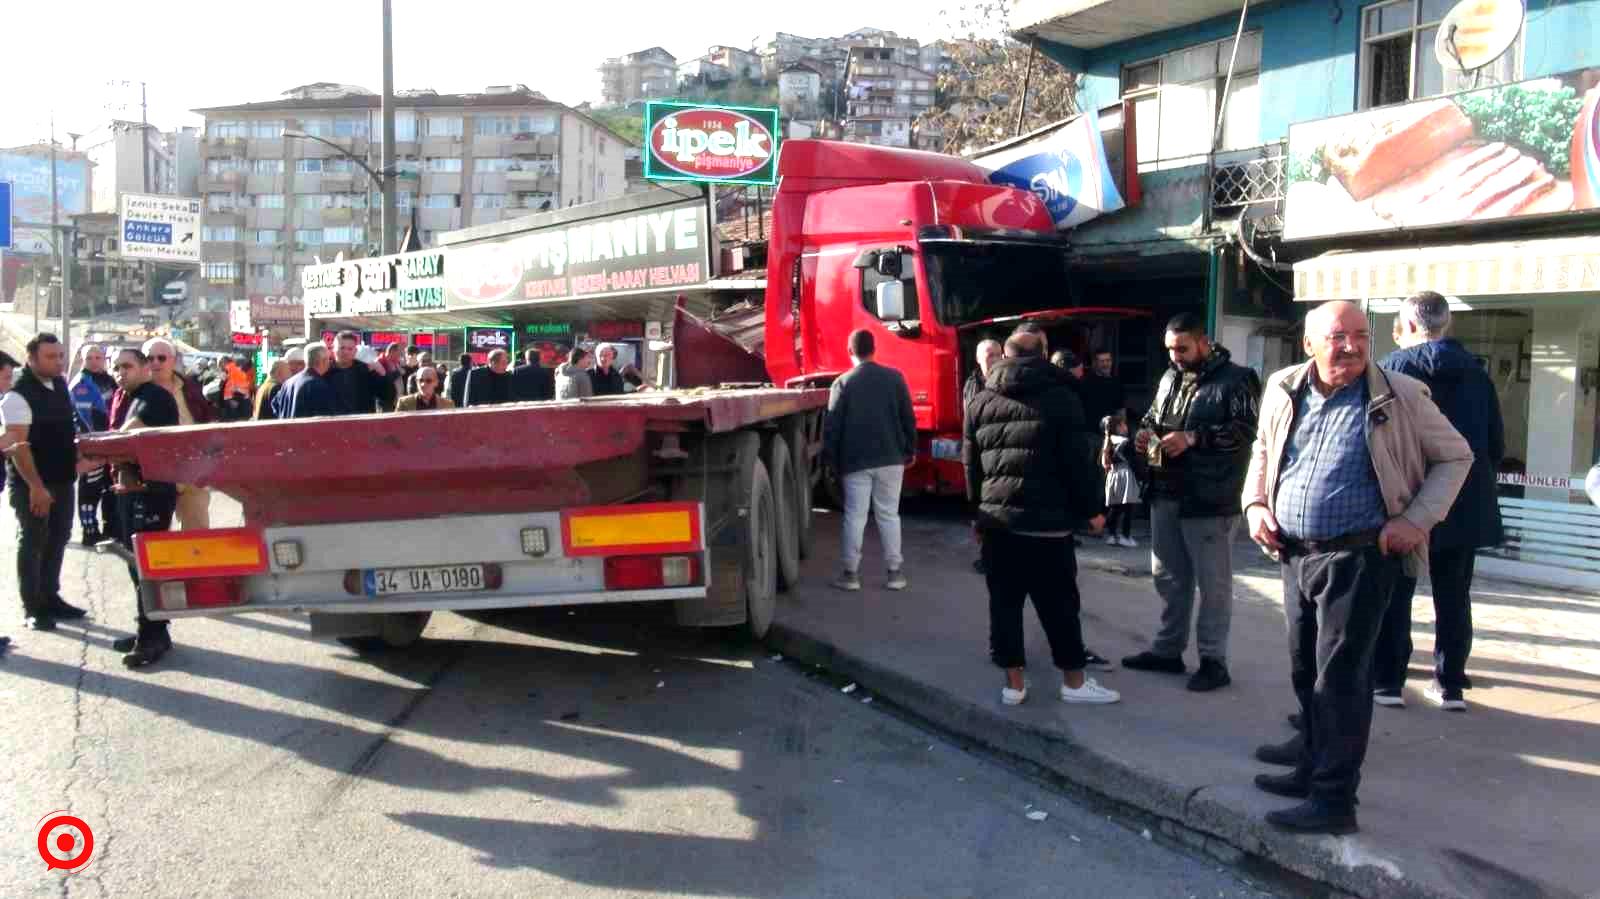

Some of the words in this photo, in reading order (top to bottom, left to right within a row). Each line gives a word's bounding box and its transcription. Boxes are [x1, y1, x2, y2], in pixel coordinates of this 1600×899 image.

[661, 117, 769, 162] ipek
[127, 222, 171, 233] Ankara
[471, 328, 507, 348] ipek
[378, 567, 398, 592] 34
[409, 568, 432, 591] UA
